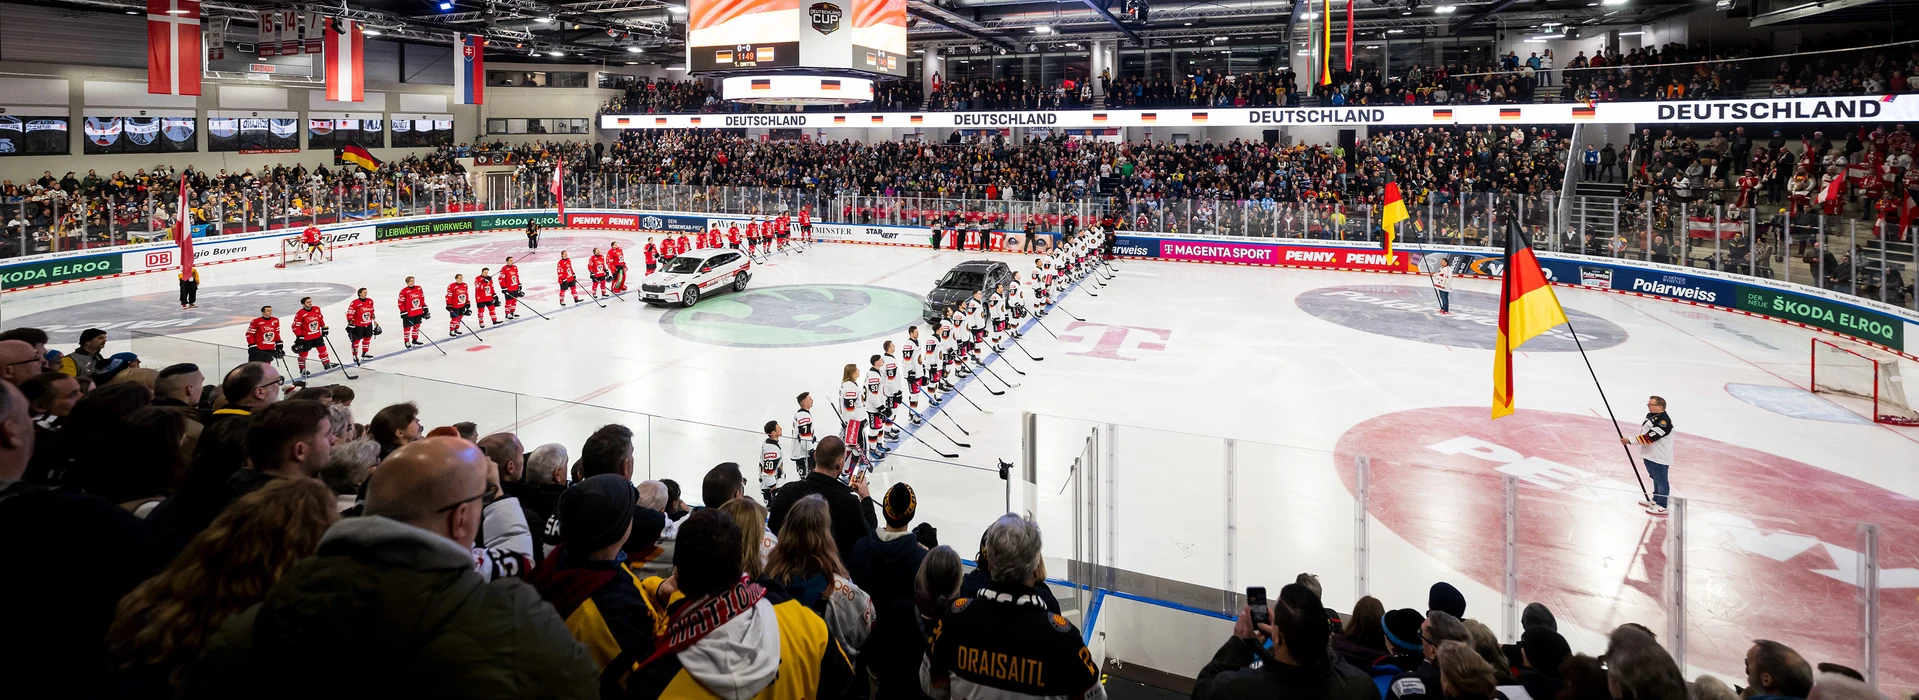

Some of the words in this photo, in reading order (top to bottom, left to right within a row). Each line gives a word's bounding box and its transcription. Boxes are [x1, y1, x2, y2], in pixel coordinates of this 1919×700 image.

[261, 13, 273, 33] 15
[283, 11, 296, 31] 14
[813, 14, 838, 24] CUP
[737, 52, 754, 60] 1:49
[1657, 99, 1882, 120] DEUTSCHLAND
[725, 115, 806, 126] DEUTSCHLAND
[954, 113, 1057, 125] DEUTSCHLAND
[1249, 109, 1385, 123] DEUTSCHLAND
[494, 217, 528, 226] ŠKODA
[385, 224, 430, 237] LEIBWÄCHTER
[433, 221, 472, 232] WORKWEAR
[194, 250, 209, 259] gio
[213, 246, 247, 257] Bayern
[1112, 244, 1148, 255] arweiss
[1175, 245, 1231, 258] MAGENTA
[1232, 248, 1272, 260] SPORT
[149, 253, 169, 265] DB
[0, 268, 47, 283] KODA
[52, 260, 111, 277] ELROQ
[1632, 277, 1717, 302] Polarweiss
[1747, 293, 1763, 301] DER
[1747, 300, 1769, 308] NEUE
[1772, 295, 1835, 324] ŠKODA
[1839, 313, 1894, 340] ELROQ
[802, 425, 809, 434] 7
[765, 460, 774, 470] 50
[957, 645, 1045, 687] DRAISAITL
